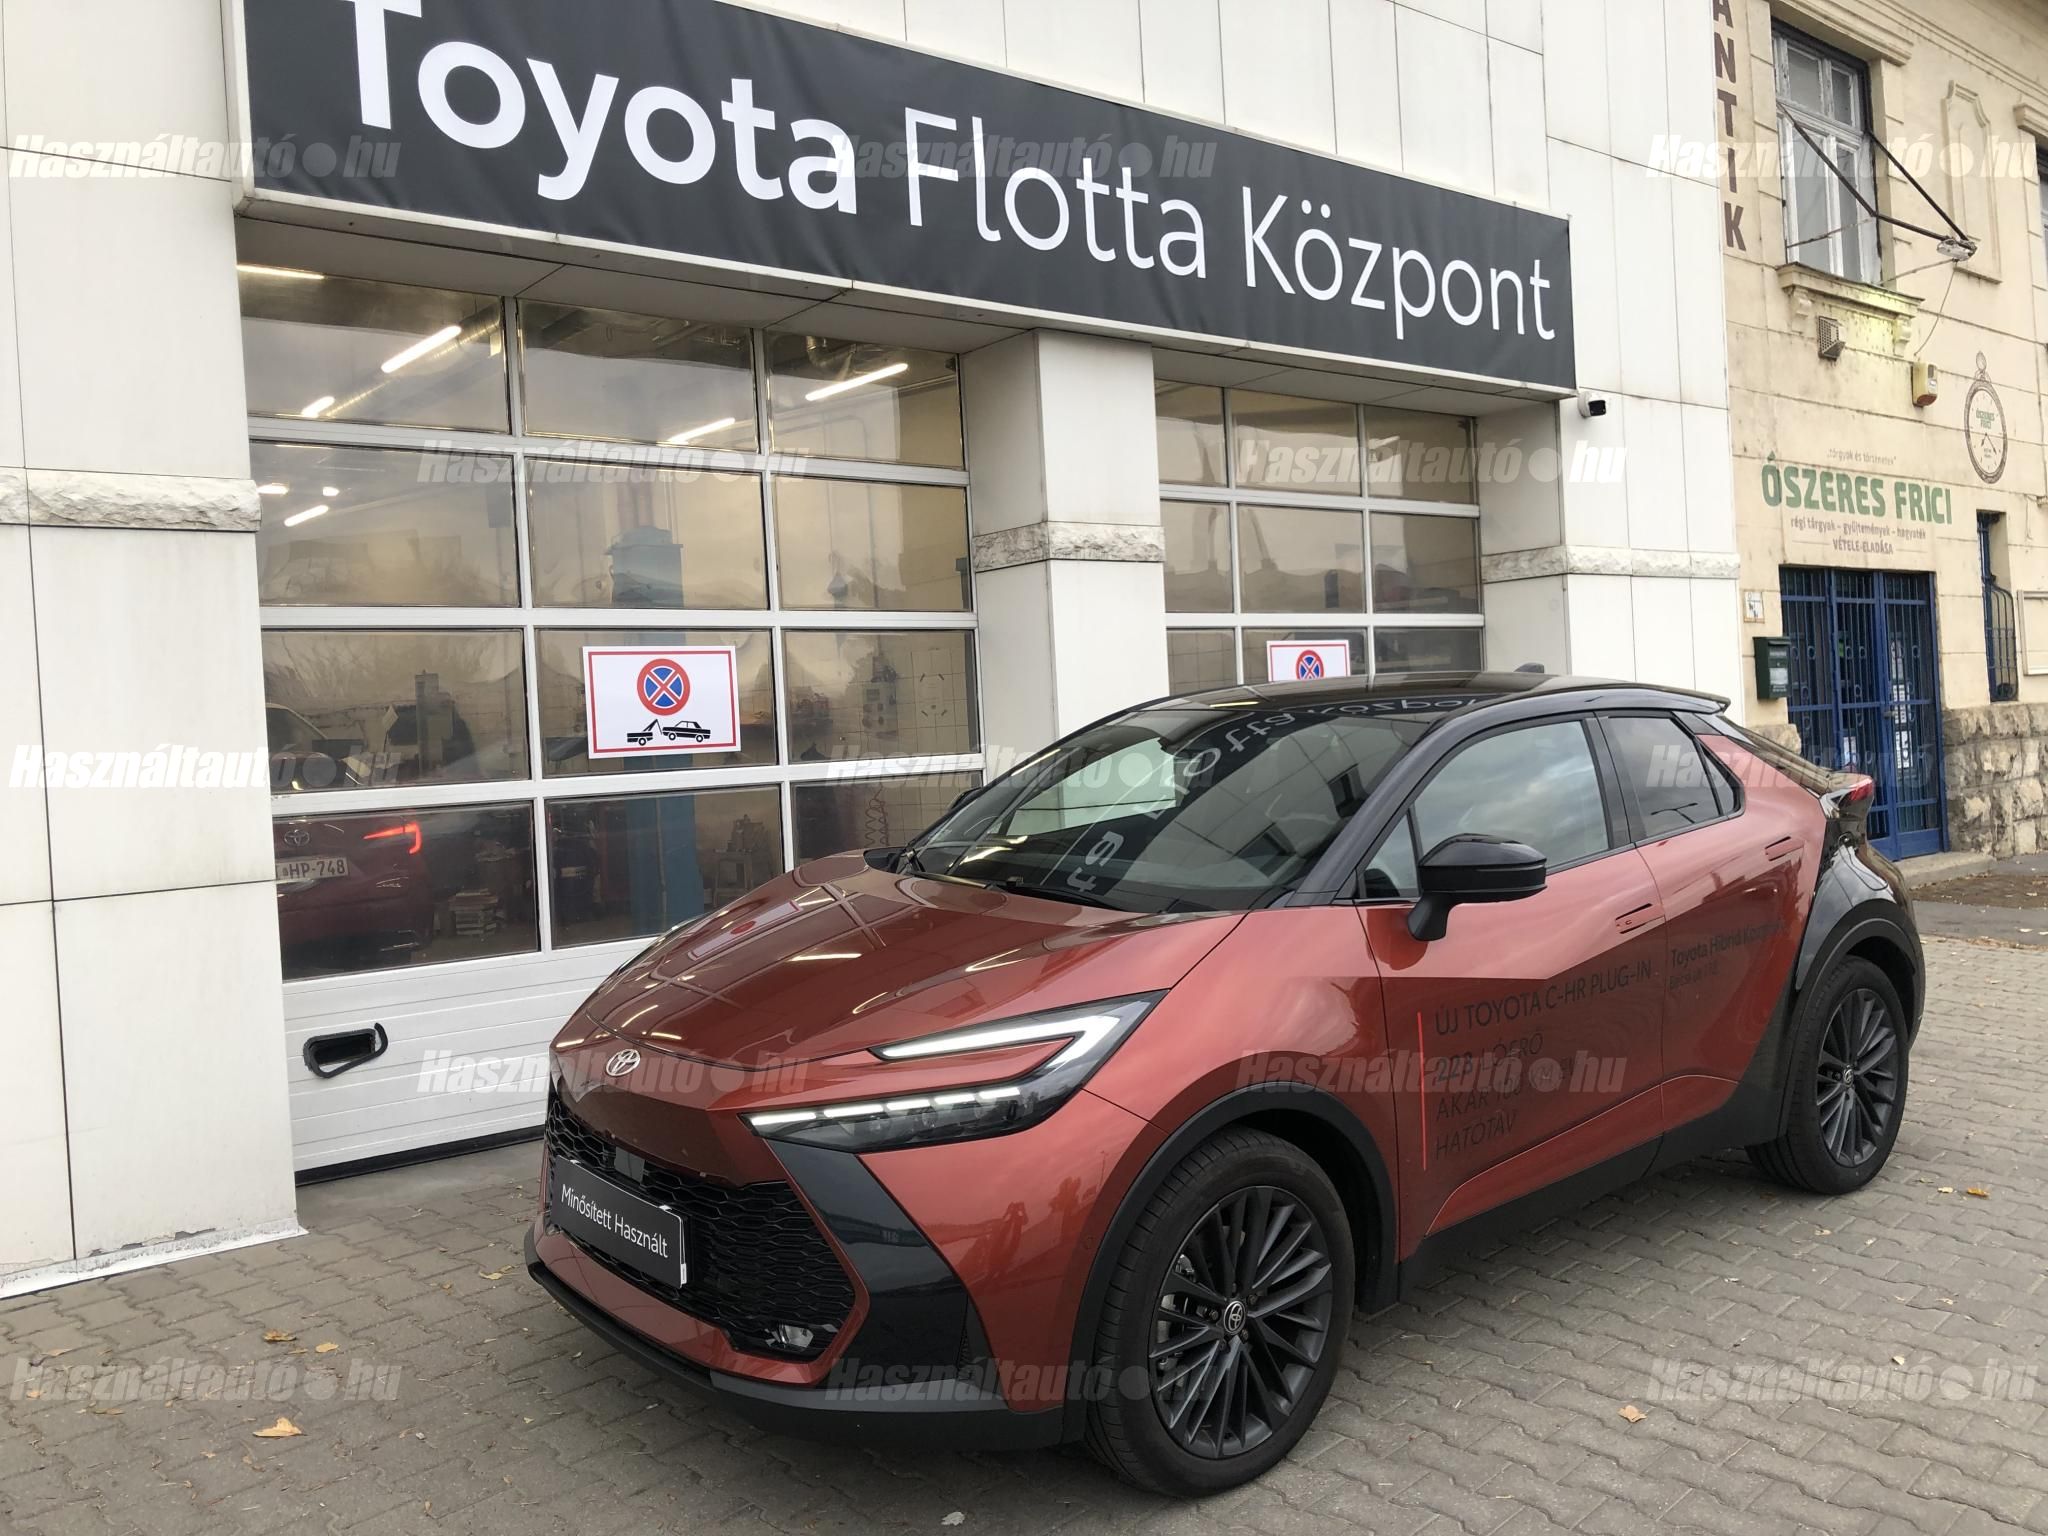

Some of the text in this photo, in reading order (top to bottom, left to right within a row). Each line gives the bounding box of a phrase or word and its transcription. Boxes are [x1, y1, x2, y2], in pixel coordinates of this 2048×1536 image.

[1712, 0, 1746, 252] ANTIK
[344, 0, 1556, 340] Toyota Flotta Központ
[1790, 516, 1806, 531] régi
[1807, 517, 1836, 533] tárgyak
[1894, 481, 1953, 525] FRICI
[1671, 942, 1709, 969] Toyota
[1434, 959, 1652, 1037] ÚJ TOYOTA C-HR PLUG-IN
[1435, 1051, 1473, 1082] 223
[1435, 1109, 1519, 1161] HATÓTÁV
[561, 1183, 668, 1259] Minősített Használt
